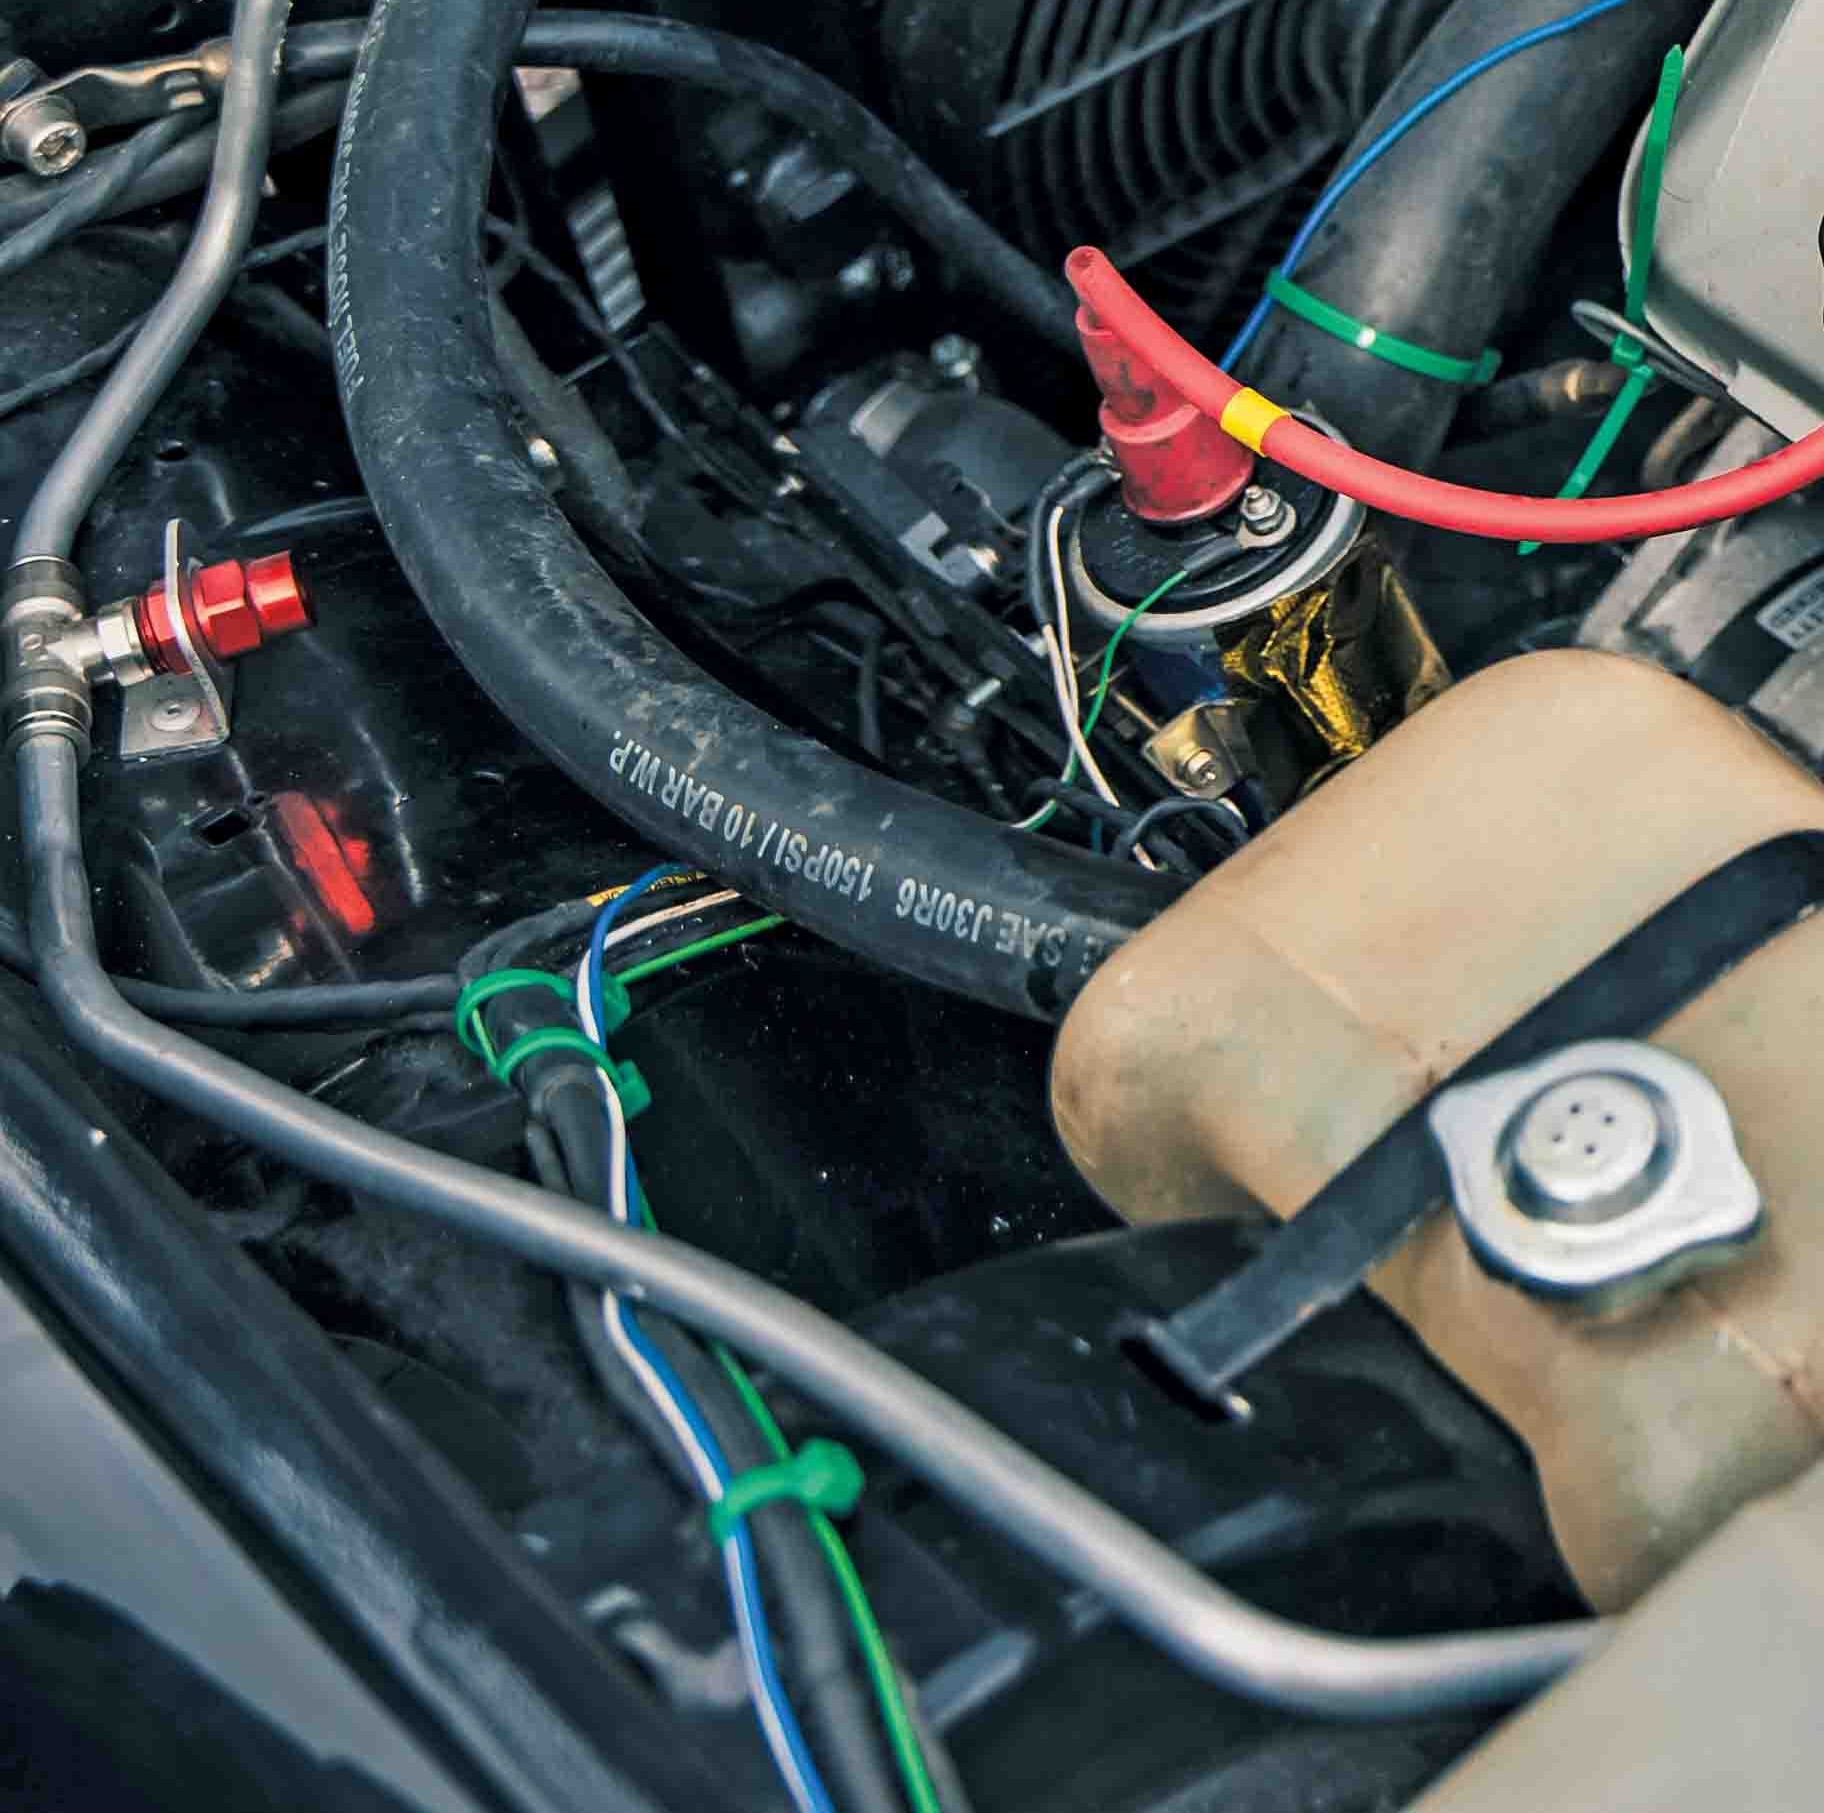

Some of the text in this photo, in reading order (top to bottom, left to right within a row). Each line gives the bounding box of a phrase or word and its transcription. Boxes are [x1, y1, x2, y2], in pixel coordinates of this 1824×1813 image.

[608, 729, 661, 796] W.P.
[660, 772, 726, 832] BAR
[723, 803, 758, 848] 10
[773, 825, 875, 903] 150PSI
[895, 876, 993, 945] J30R6
[994, 907, 1068, 967] SAE
